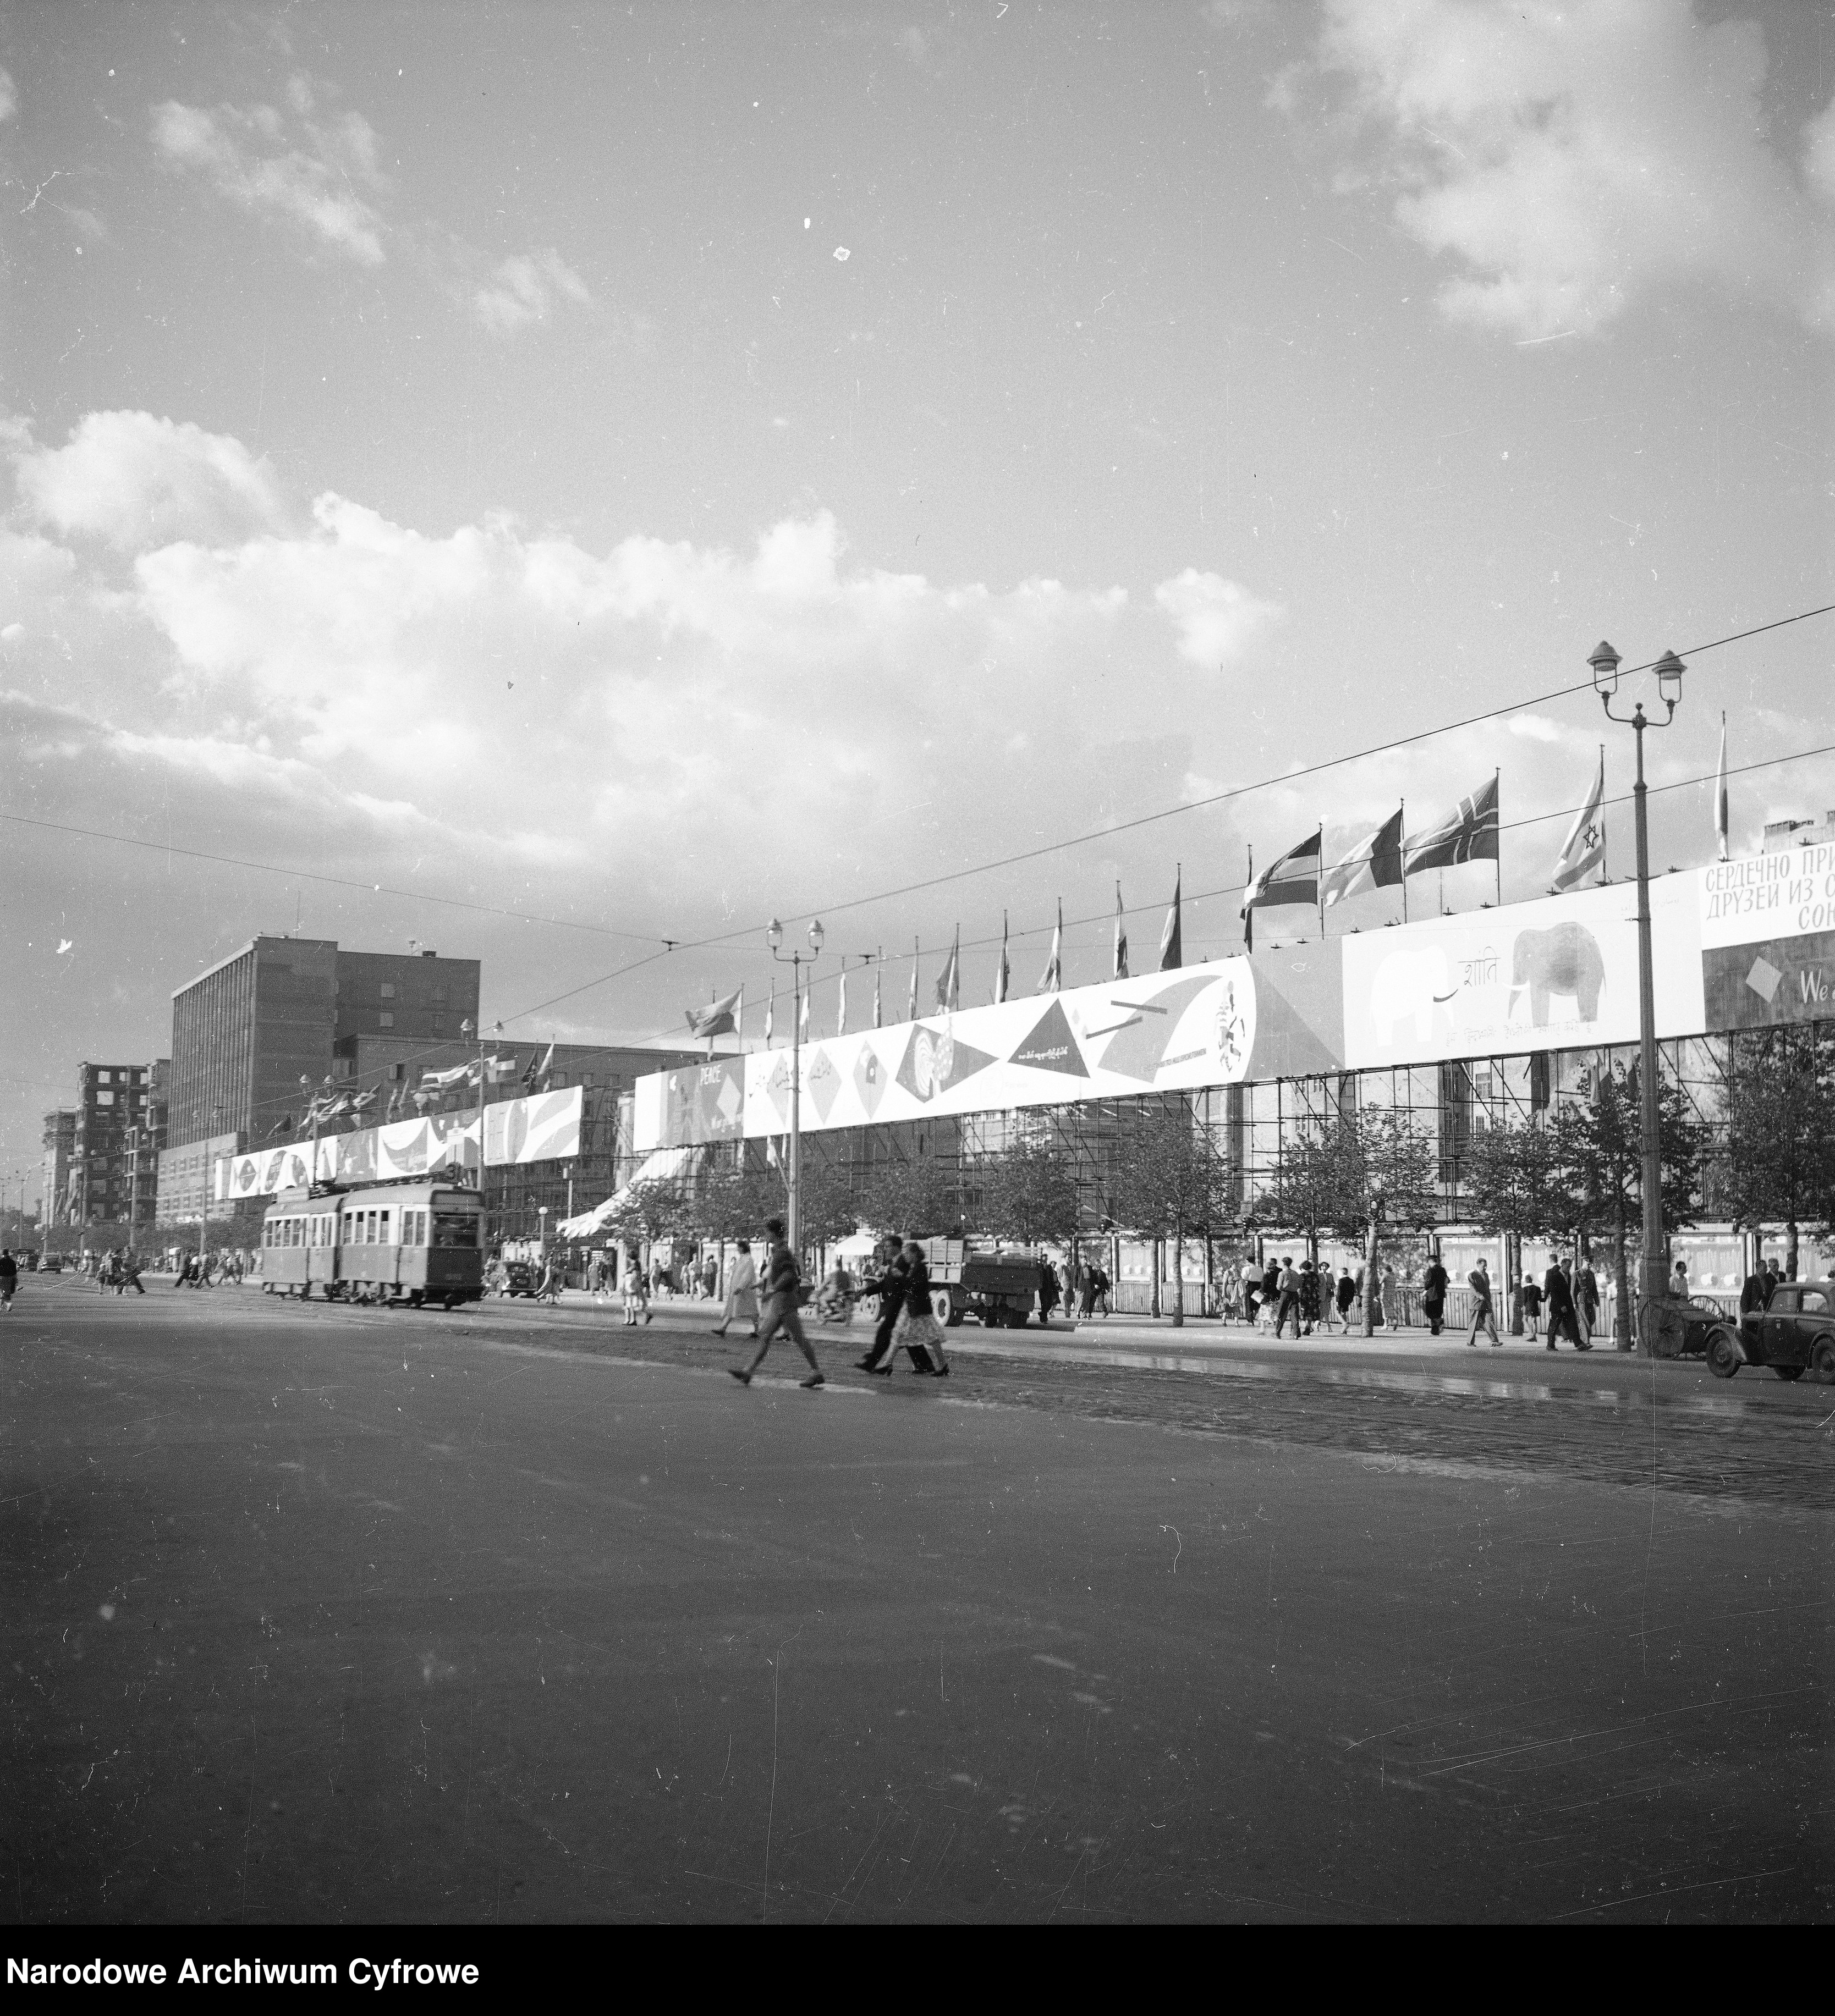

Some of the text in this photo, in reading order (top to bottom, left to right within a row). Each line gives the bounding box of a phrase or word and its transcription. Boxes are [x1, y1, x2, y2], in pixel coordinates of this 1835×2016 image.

[1706, 855, 1790, 892] СЕРДЕЧНО
[1706, 883, 1779, 921] ДРУЗЕЙ
[1789, 878, 1814, 905] ИЗ
[1800, 968, 1828, 1004] We
[700, 1064, 722, 1086] PEACE
